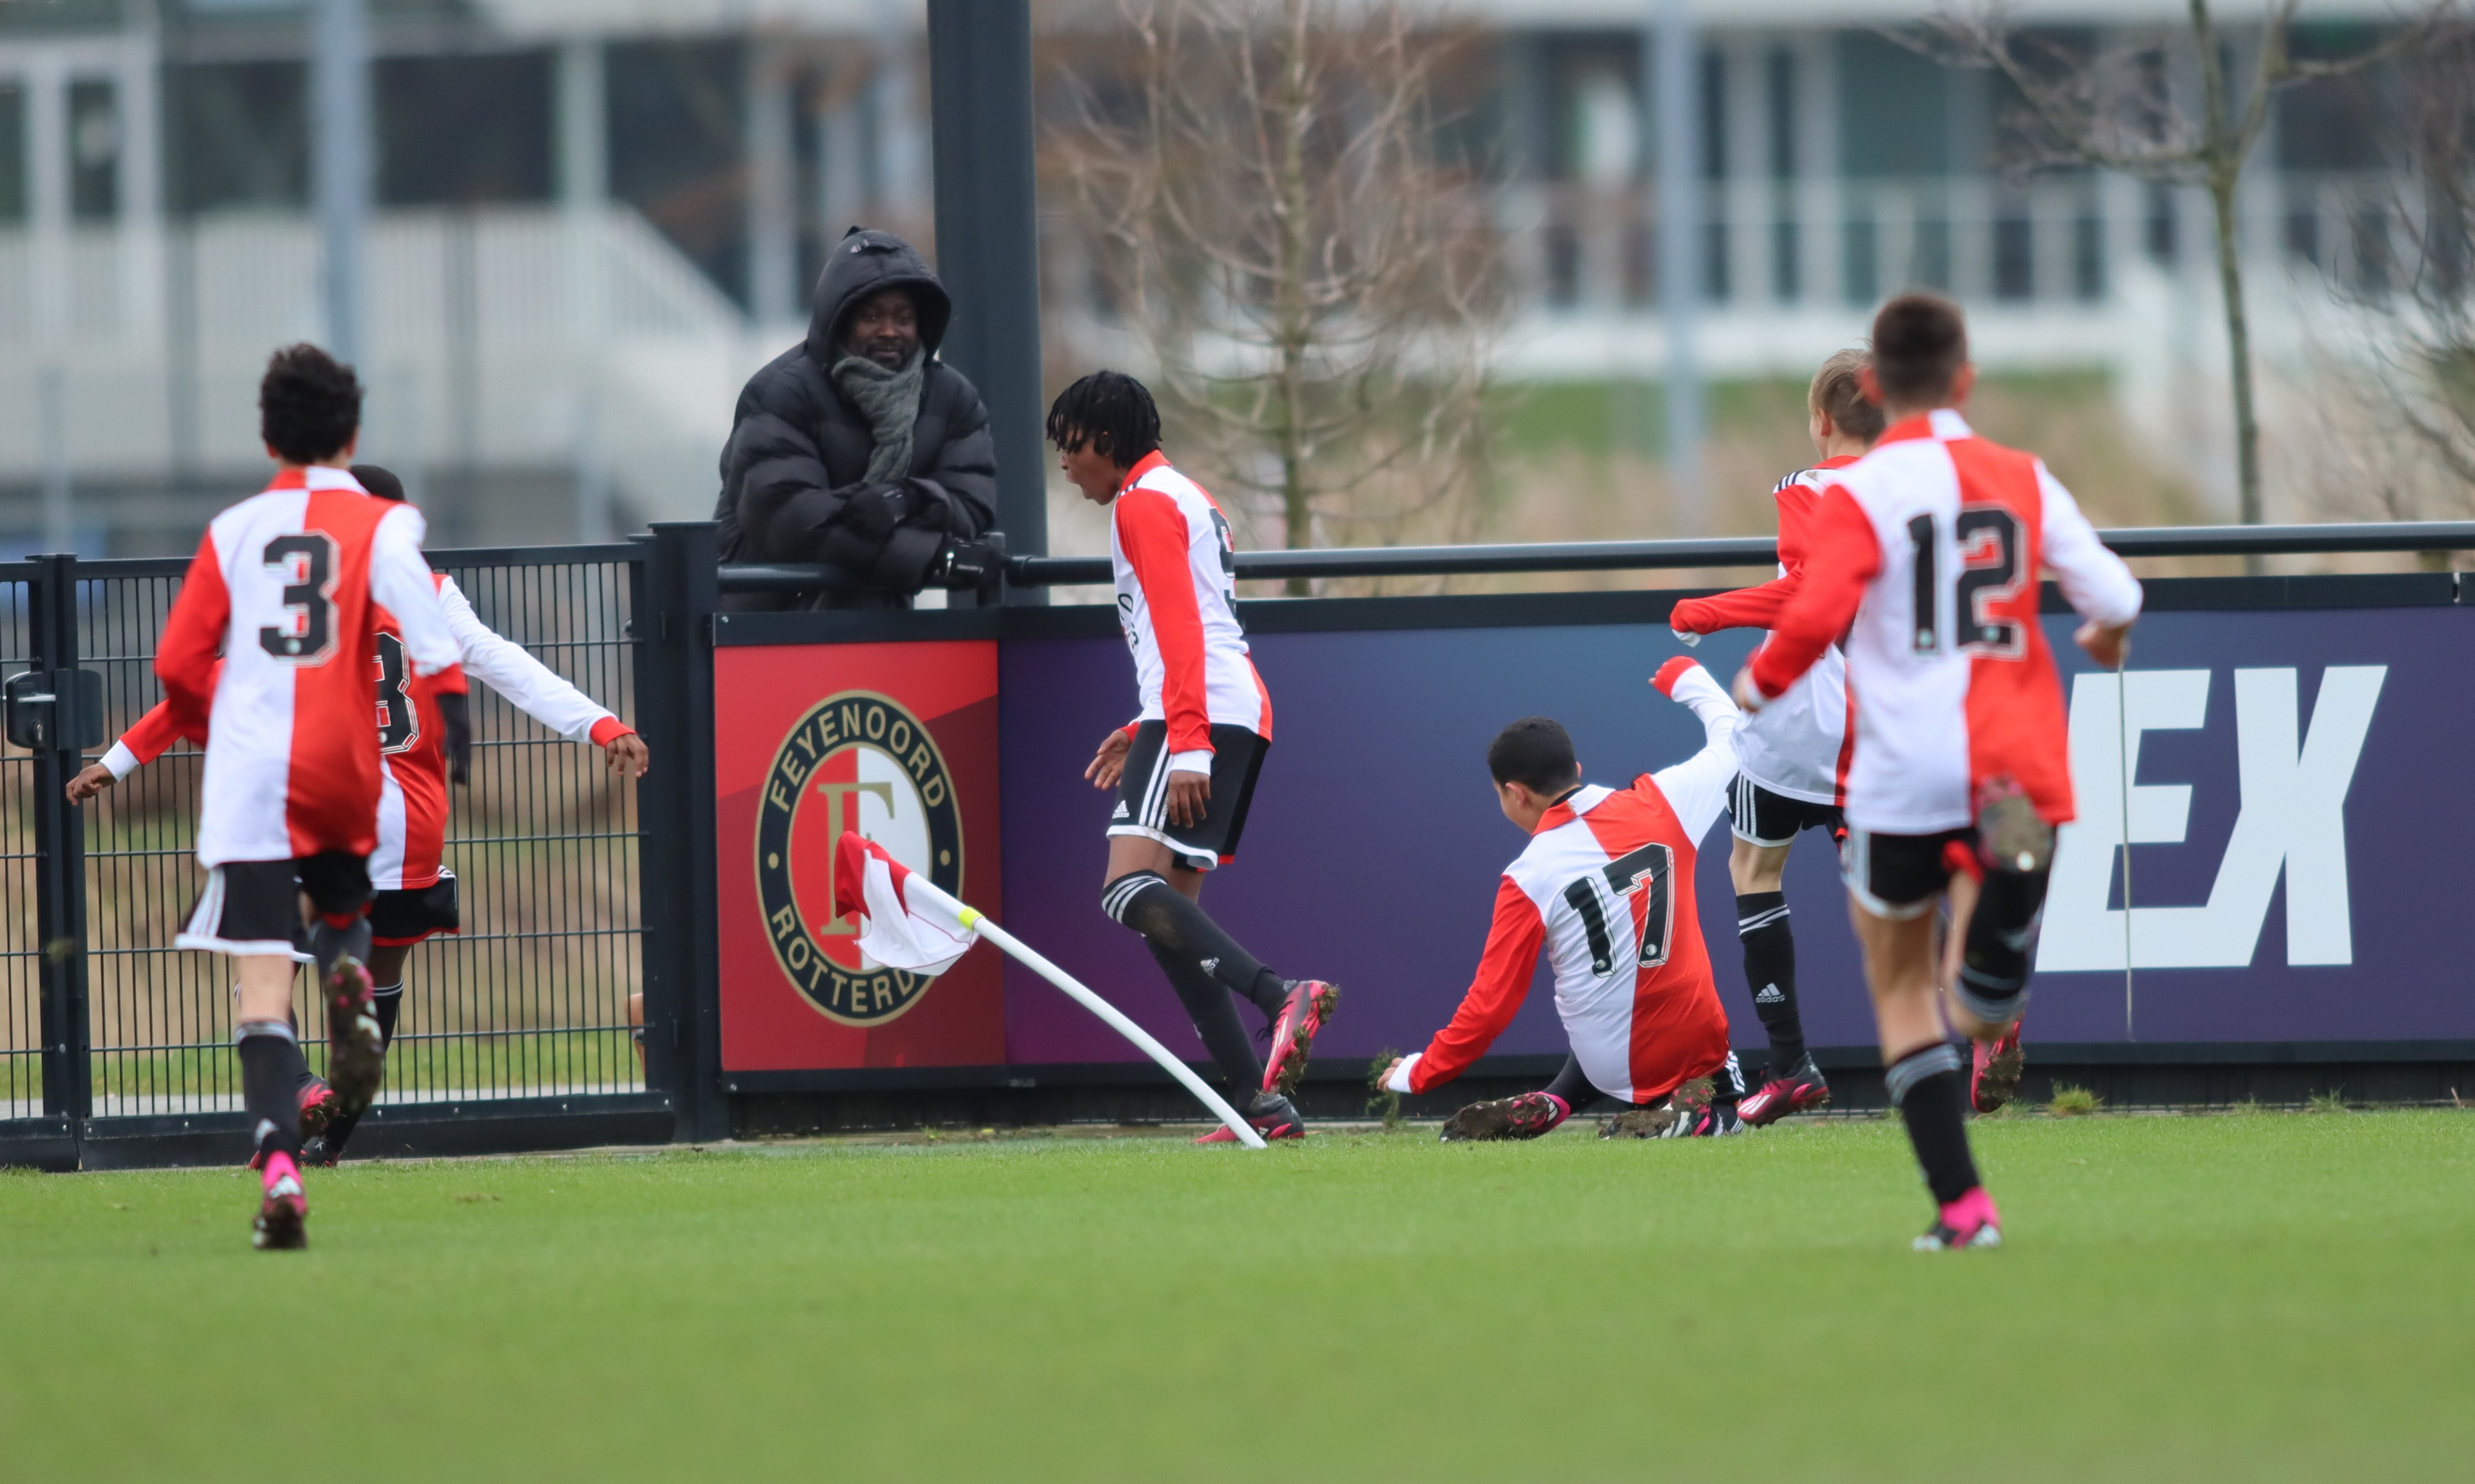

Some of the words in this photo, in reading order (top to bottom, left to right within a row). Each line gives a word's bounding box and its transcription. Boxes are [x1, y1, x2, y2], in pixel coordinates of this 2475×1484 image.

[258, 528, 340, 668] 3
[1907, 497, 2028, 662] 12
[770, 704, 945, 813] FEYENOORD
[2035, 665, 2388, 972] EX
[772, 904, 915, 1012] ROTTERD
[1564, 842, 1675, 979] 17
[1755, 994, 1785, 1003] adidas
